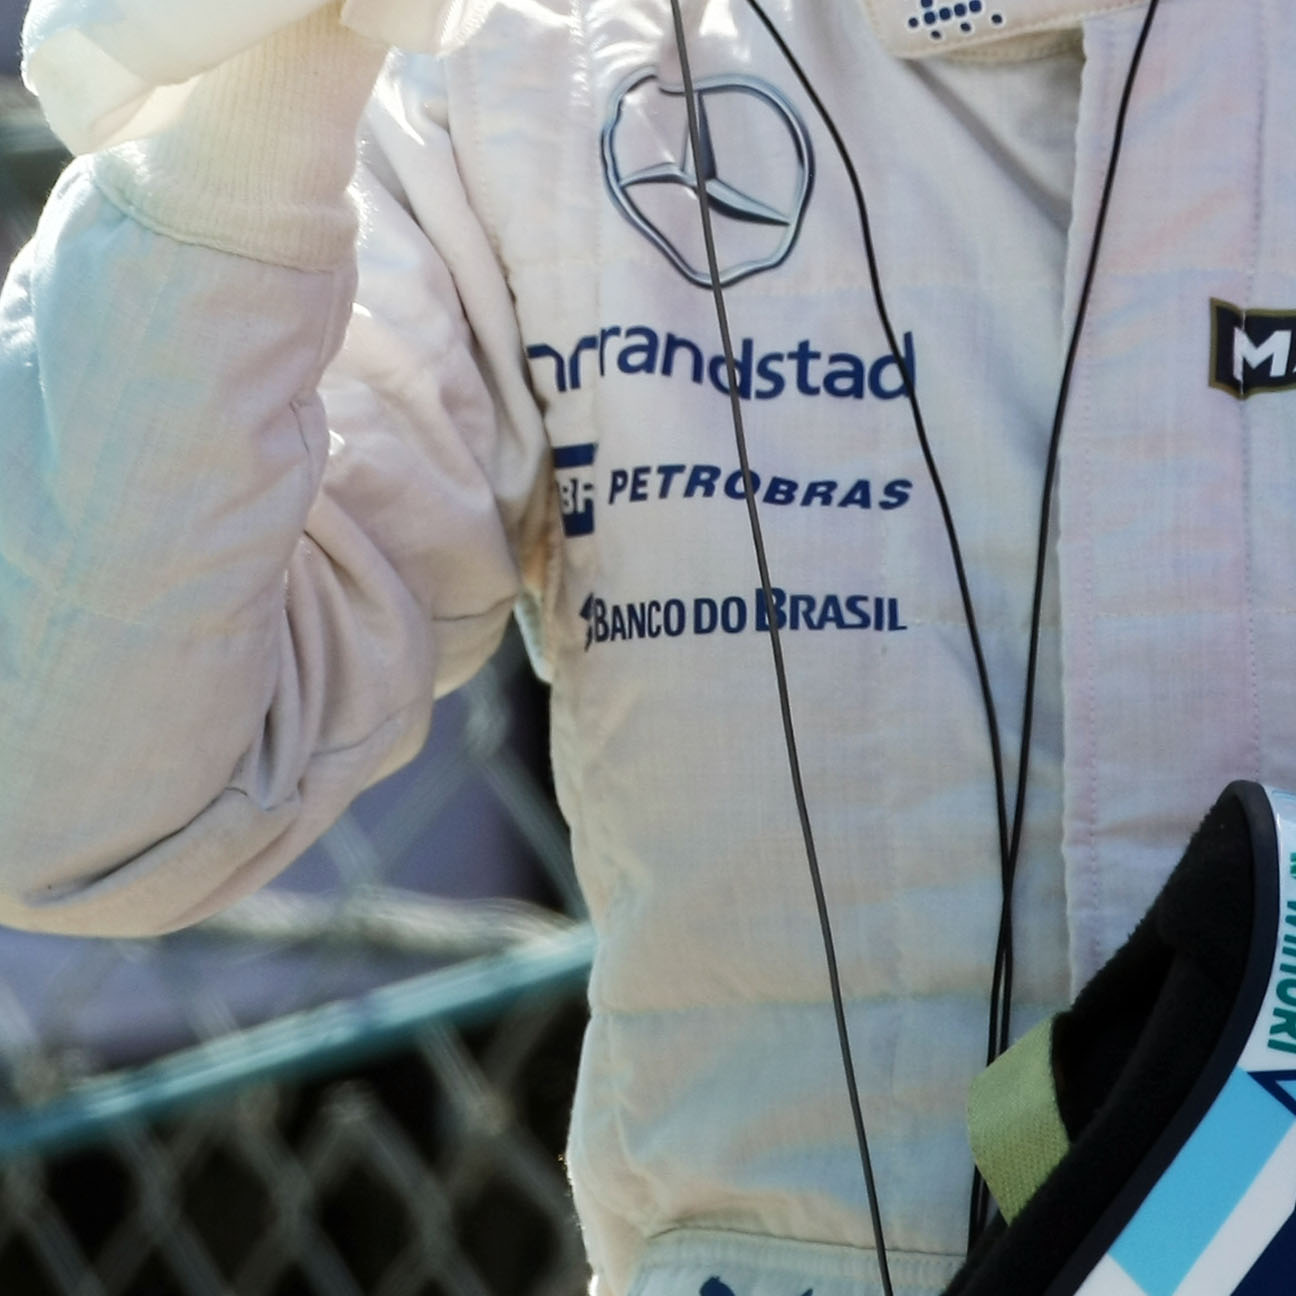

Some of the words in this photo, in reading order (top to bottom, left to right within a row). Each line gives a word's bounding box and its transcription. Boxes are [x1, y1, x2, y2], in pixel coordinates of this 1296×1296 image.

[599, 325, 916, 401] randstad
[609, 464, 914, 511] PETROBRAS
[594, 597, 686, 643] BANCO
[693, 596, 748, 635] DO
[754, 587, 908, 633] BRASIL
